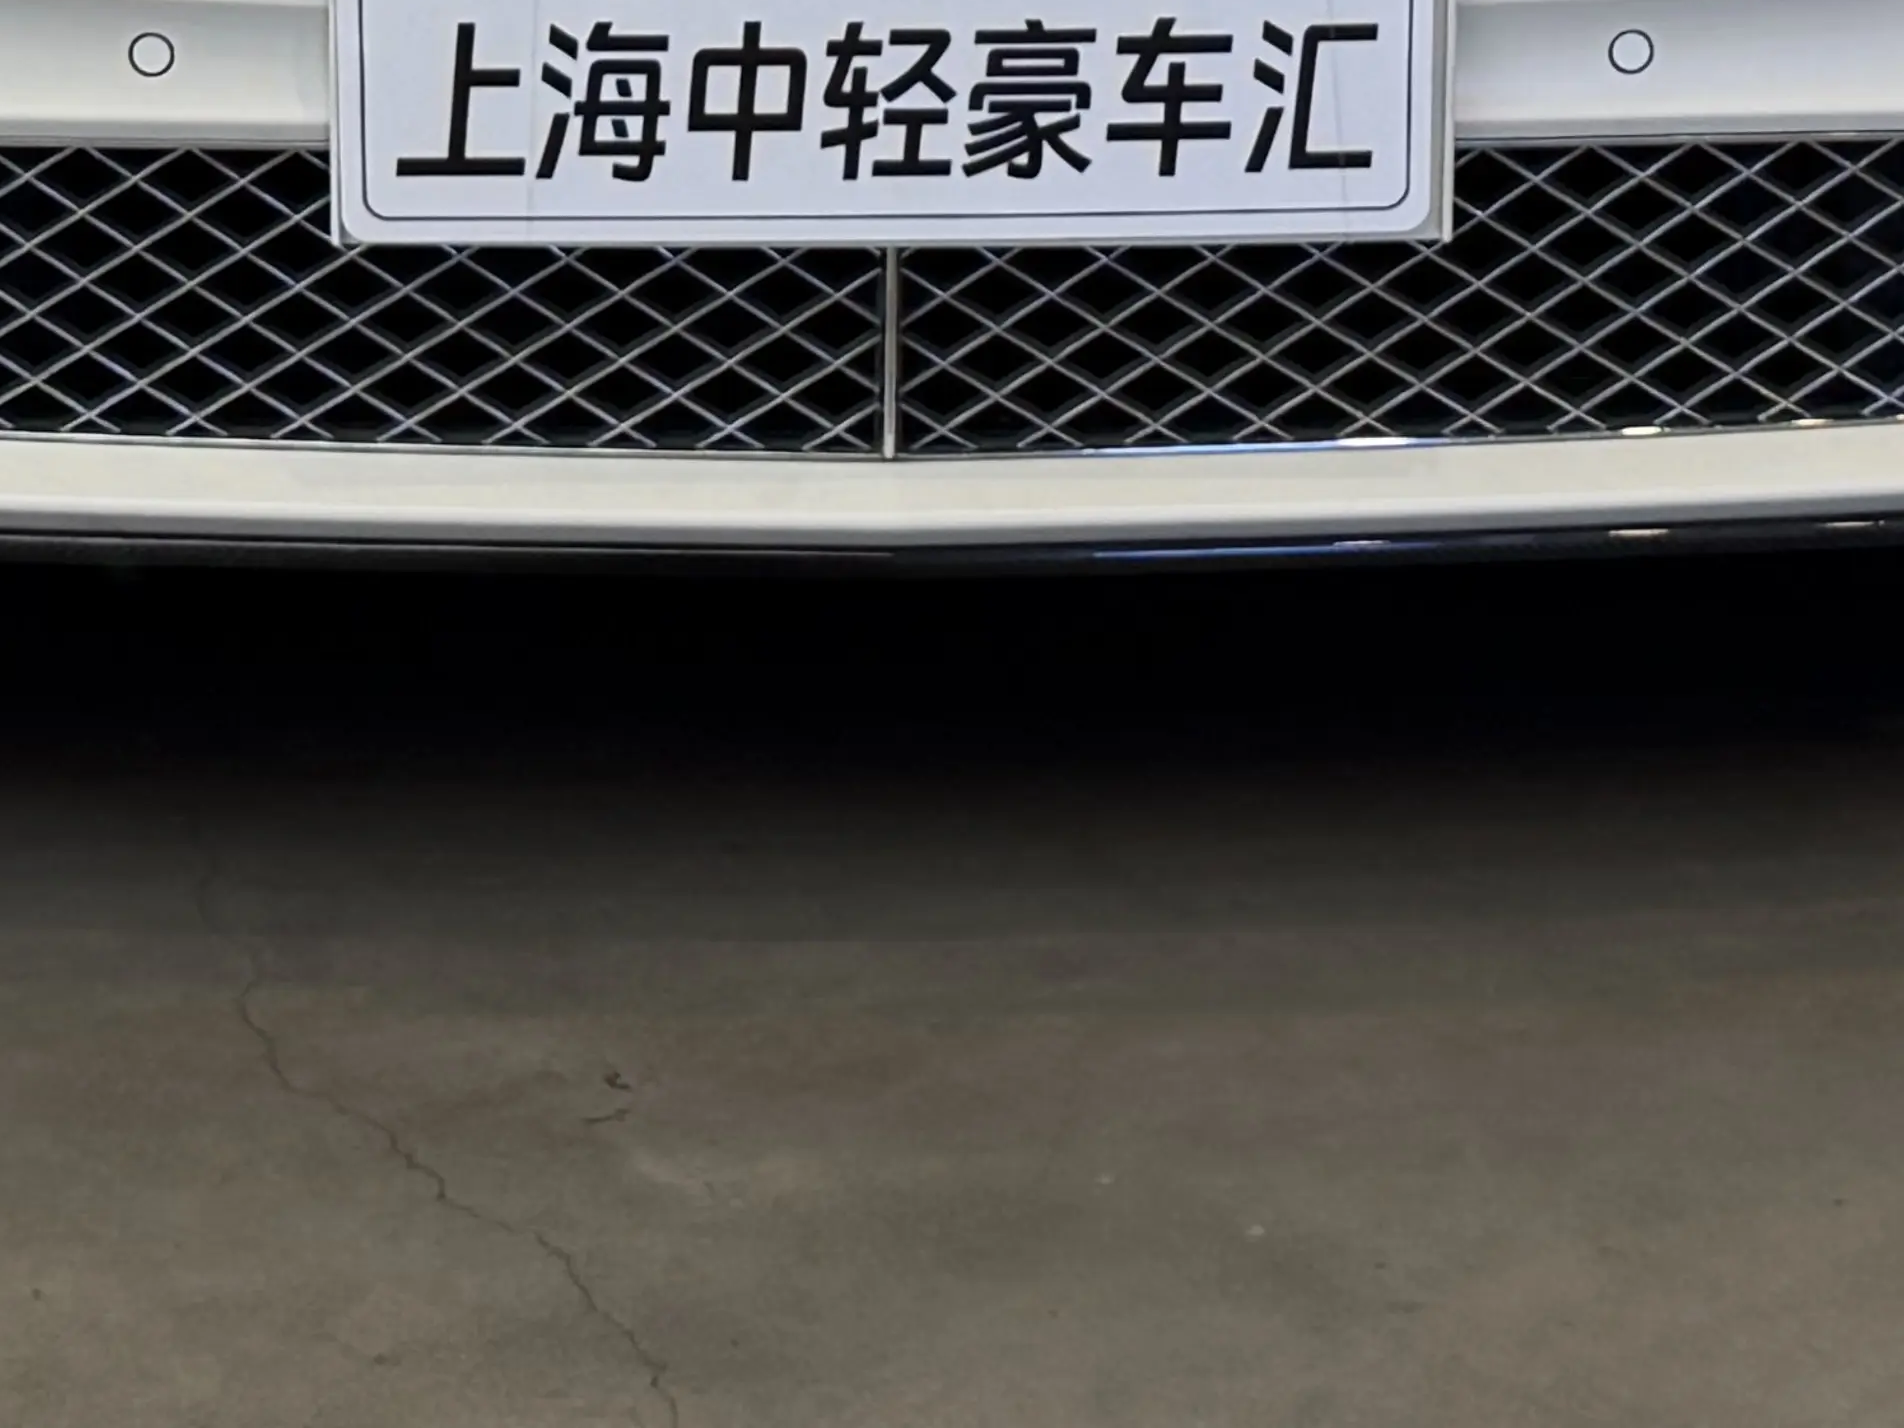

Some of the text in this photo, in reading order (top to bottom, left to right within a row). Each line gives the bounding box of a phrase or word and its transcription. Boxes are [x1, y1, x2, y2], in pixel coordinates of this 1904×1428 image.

[395, 18, 1380, 184] 上海中轻豪车汇
